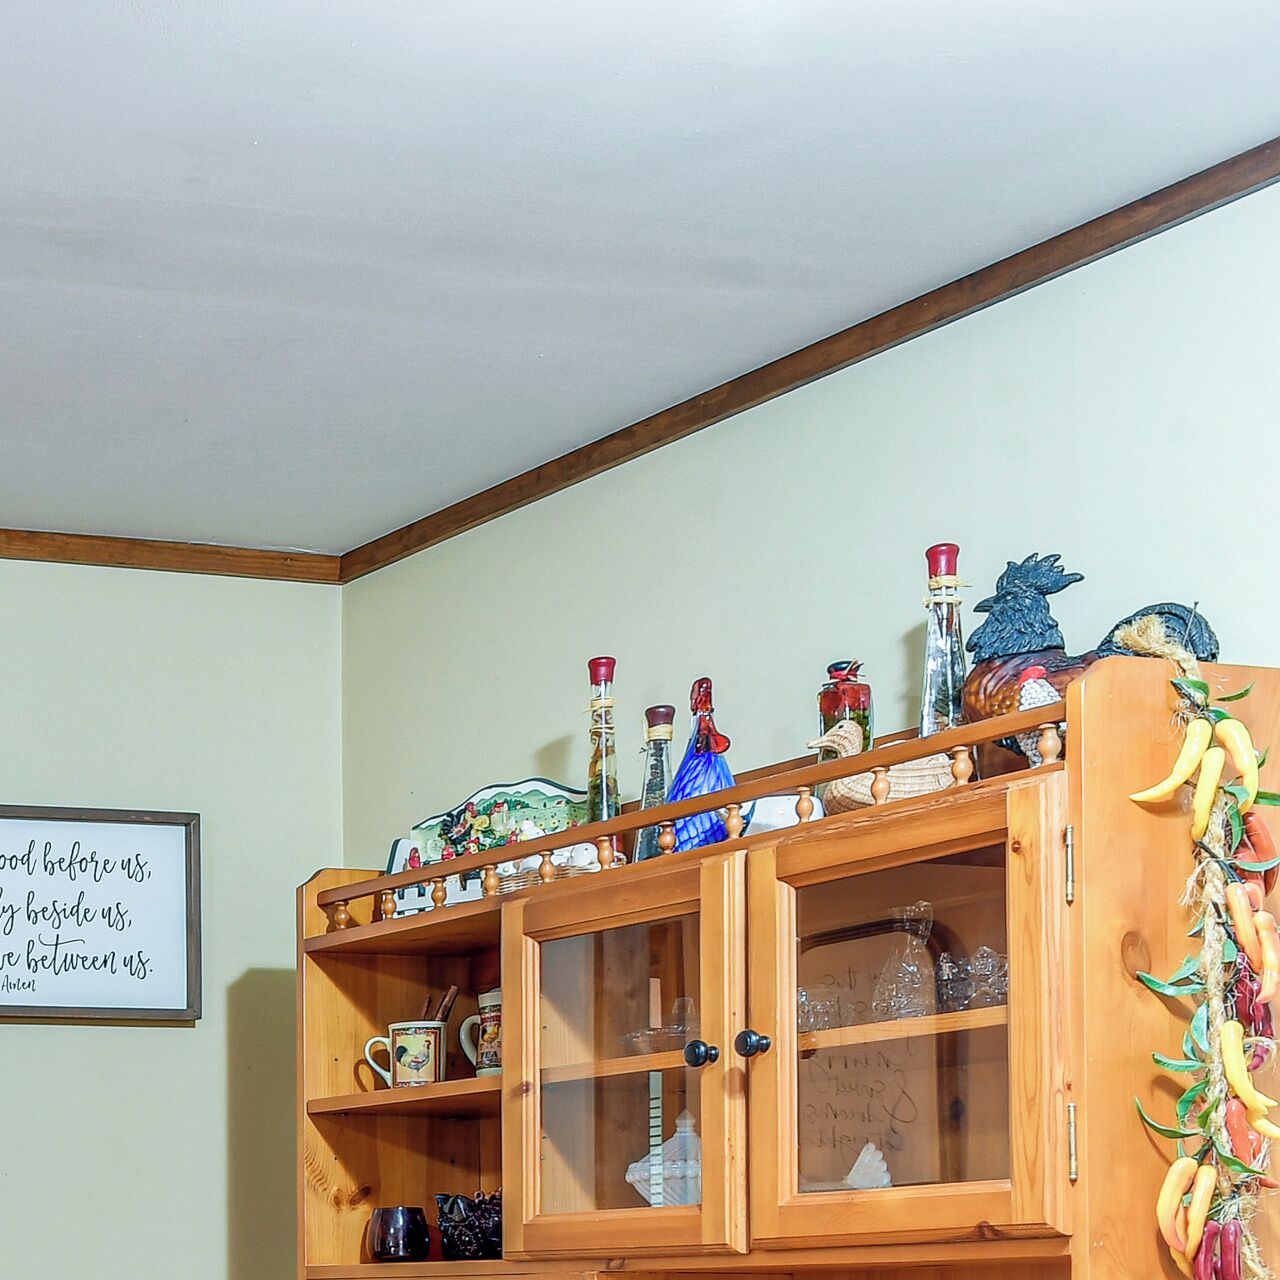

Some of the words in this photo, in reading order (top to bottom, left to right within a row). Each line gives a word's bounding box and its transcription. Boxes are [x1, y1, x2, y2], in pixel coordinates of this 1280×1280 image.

[43, 841, 116, 882] before
[121, 853, 153, 883] us,
[26, 891, 97, 929] beside
[101, 901, 132, 931] us,
[26, 933, 117, 976] between
[122, 950, 154, 980] us.
[1, 975, 36, 992] Amen
